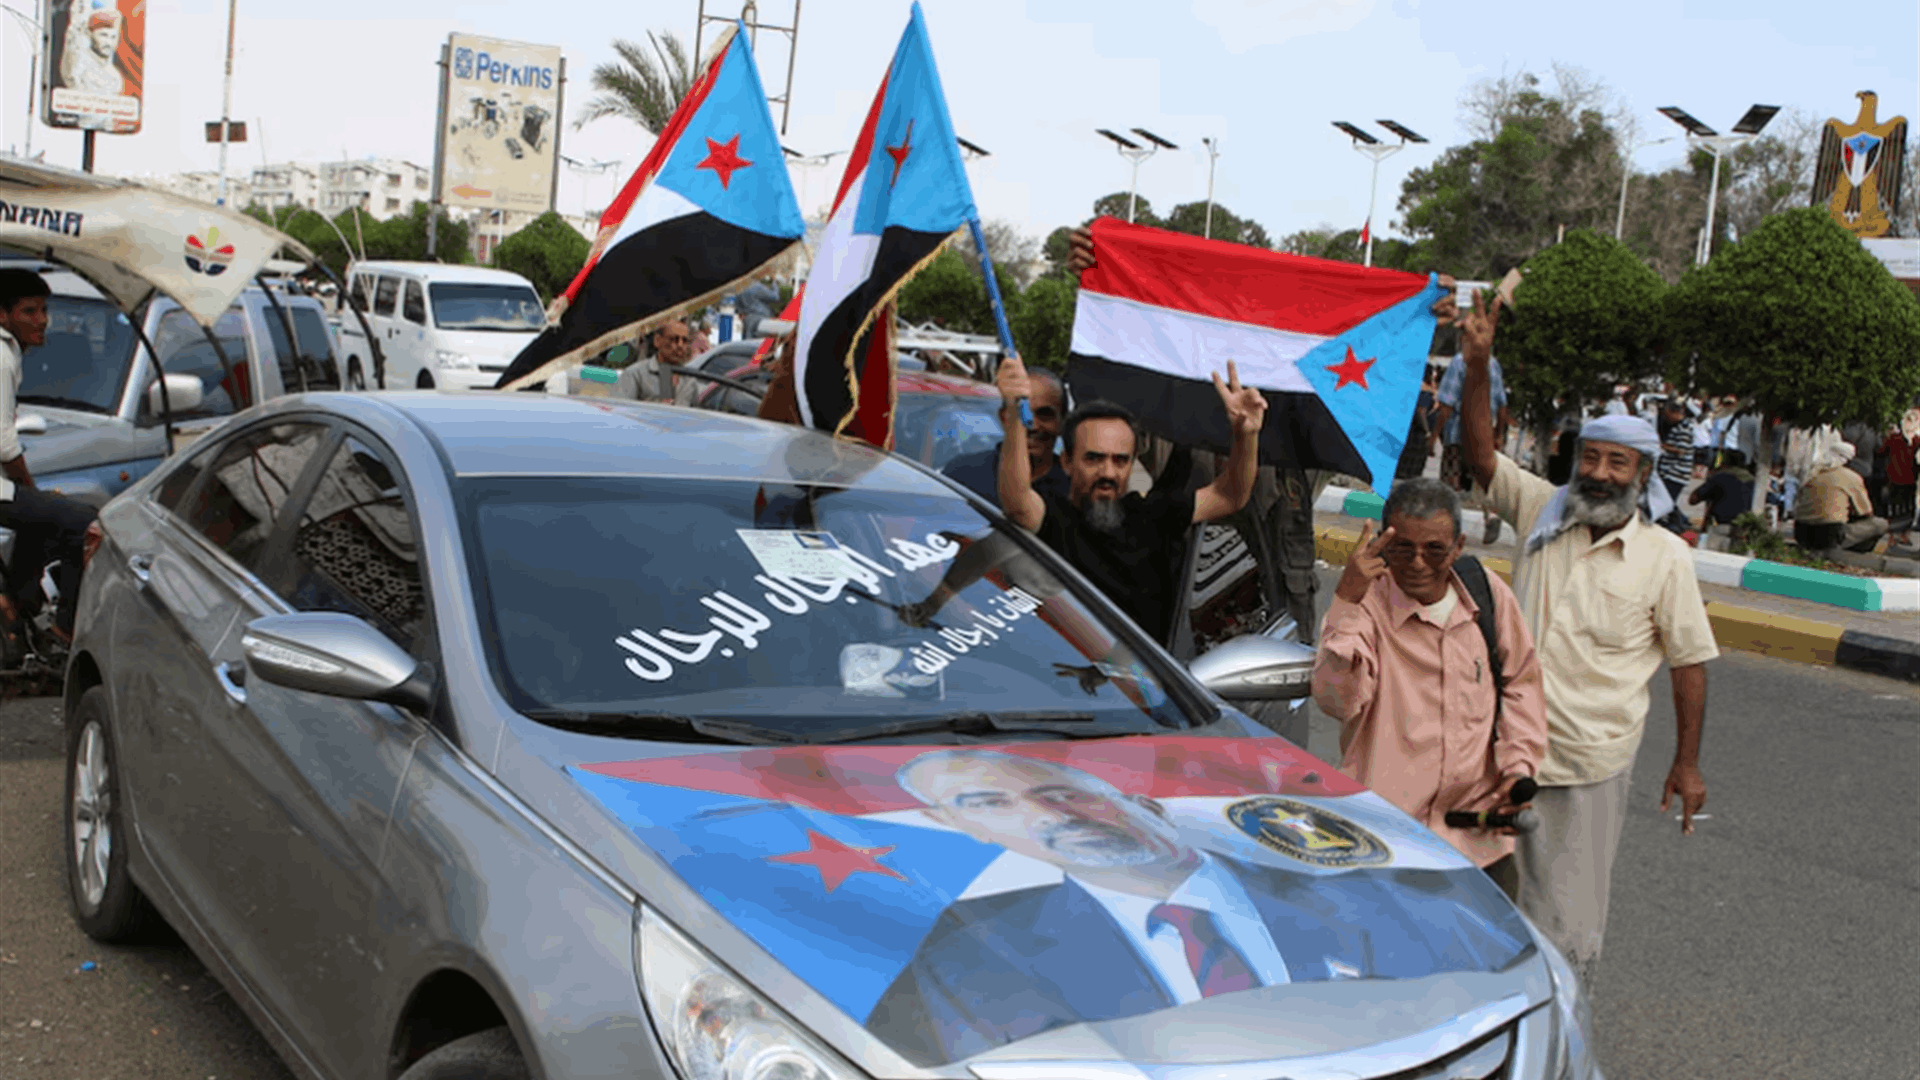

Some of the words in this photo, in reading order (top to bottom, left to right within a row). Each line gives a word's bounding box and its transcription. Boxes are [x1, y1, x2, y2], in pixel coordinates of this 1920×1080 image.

[476, 52, 552, 90] Perkins
[0, 200, 83, 237] NANA
[884, 532, 960, 572] عهد
[754, 543, 896, 615] الرجال
[615, 590, 771, 681] للرجال
[938, 622, 999, 653] رجال
[970, 609, 1014, 633] يا
[909, 640, 957, 674] الله
